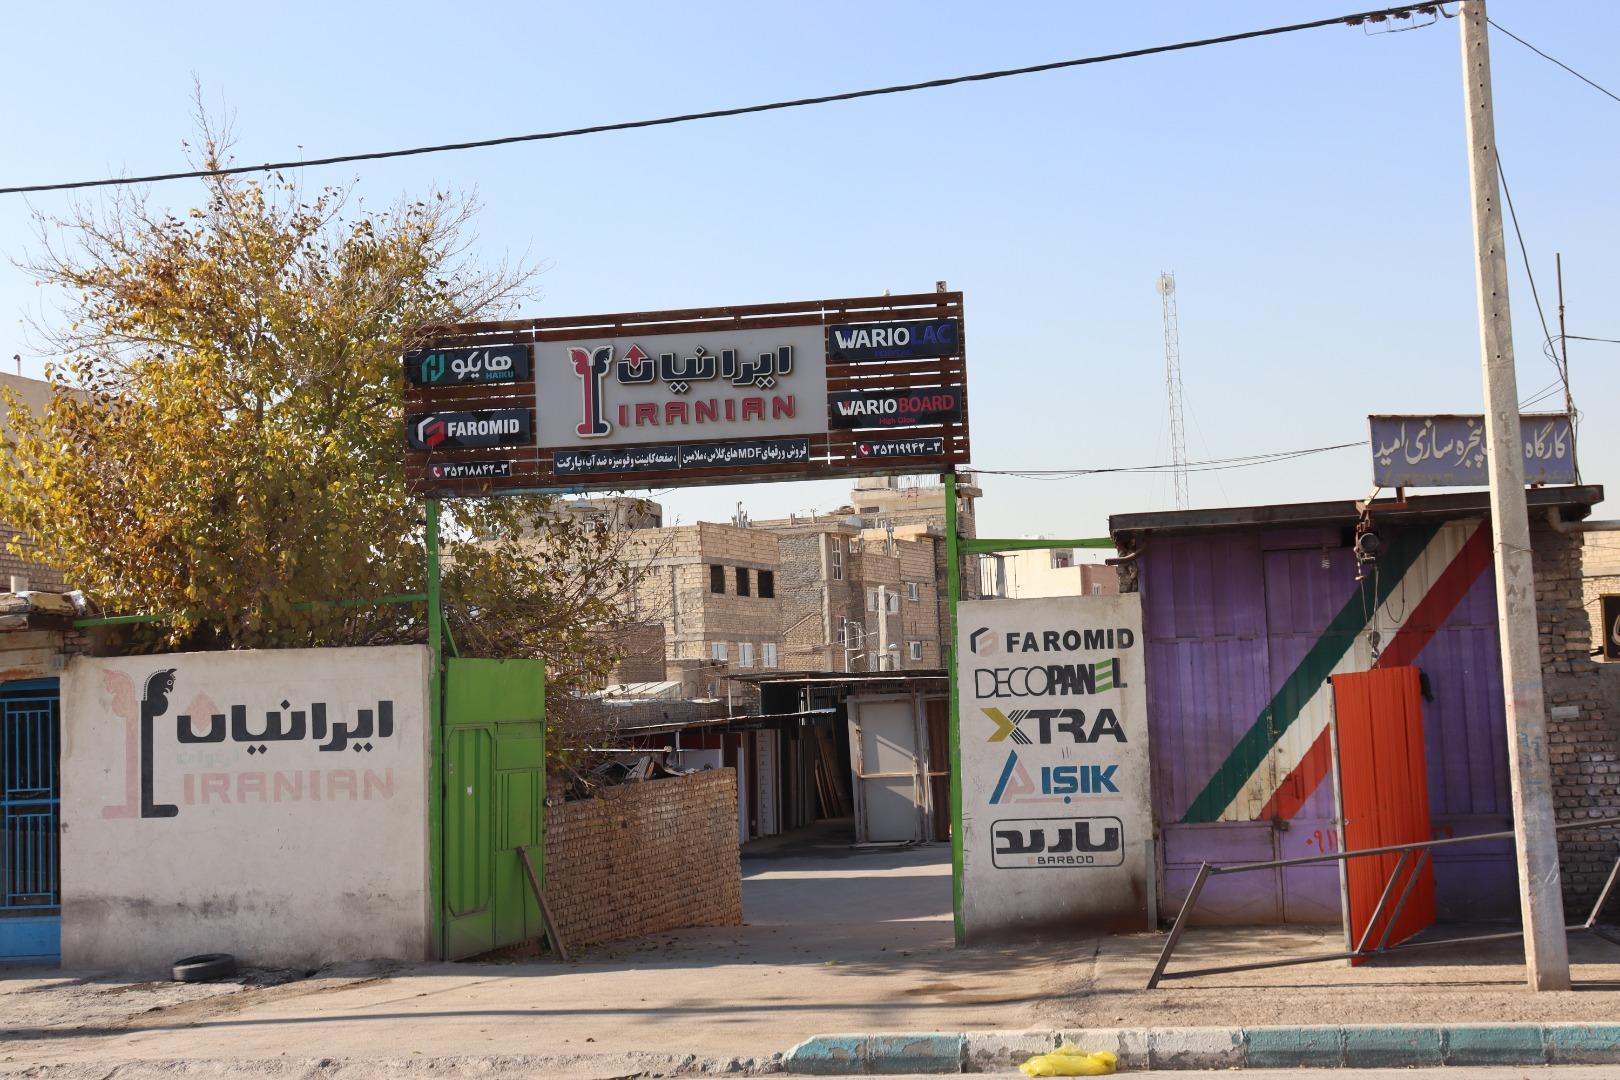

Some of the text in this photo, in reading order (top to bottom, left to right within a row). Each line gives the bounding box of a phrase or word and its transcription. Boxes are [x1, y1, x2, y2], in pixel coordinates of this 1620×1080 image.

[452, 351, 512, 380] هایکو
[486, 371, 514, 380] HAIKU
[617, 343, 792, 393] ایرانیان
[618, 395, 796, 426] IRANIAN
[447, 418, 520, 437] FAROMID
[1405, 419, 1454, 465] سازی
[1525, 420, 1569, 460] کارگاه
[738, 447, 762, 459] MDF
[786, 442, 807, 459] فروش
[1374, 422, 1405, 466] امید
[556, 455, 583, 471] پارکت
[596, 456, 608, 466] ضد
[1006, 628, 1135, 653] FAROMID
[975, 657, 1128, 698] DECOPANEL
[176, 692, 394, 756] ایرانیان
[979, 707, 1128, 744] XTRA
[183, 768, 394, 806] IRANIAN
[1037, 855, 1095, 865] BARBOD
